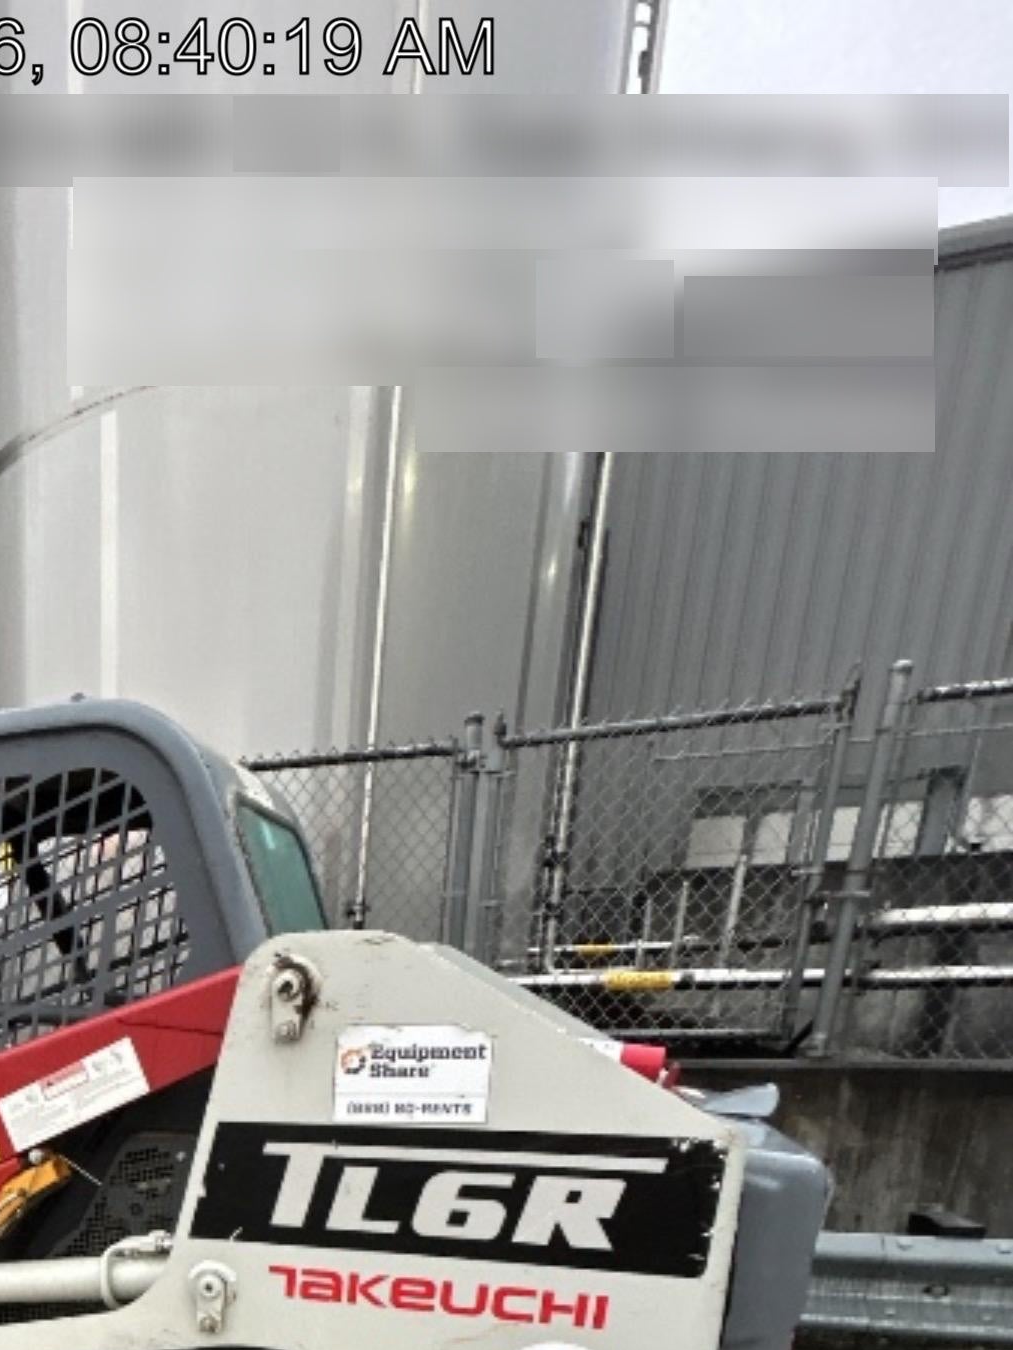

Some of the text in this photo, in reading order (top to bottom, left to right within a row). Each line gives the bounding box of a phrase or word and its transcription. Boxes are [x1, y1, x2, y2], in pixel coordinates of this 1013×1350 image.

[369, 1042, 487, 1062] Equipment
[369, 1063, 430, 1078] Share
[262, 1141, 669, 1252] TL6R
